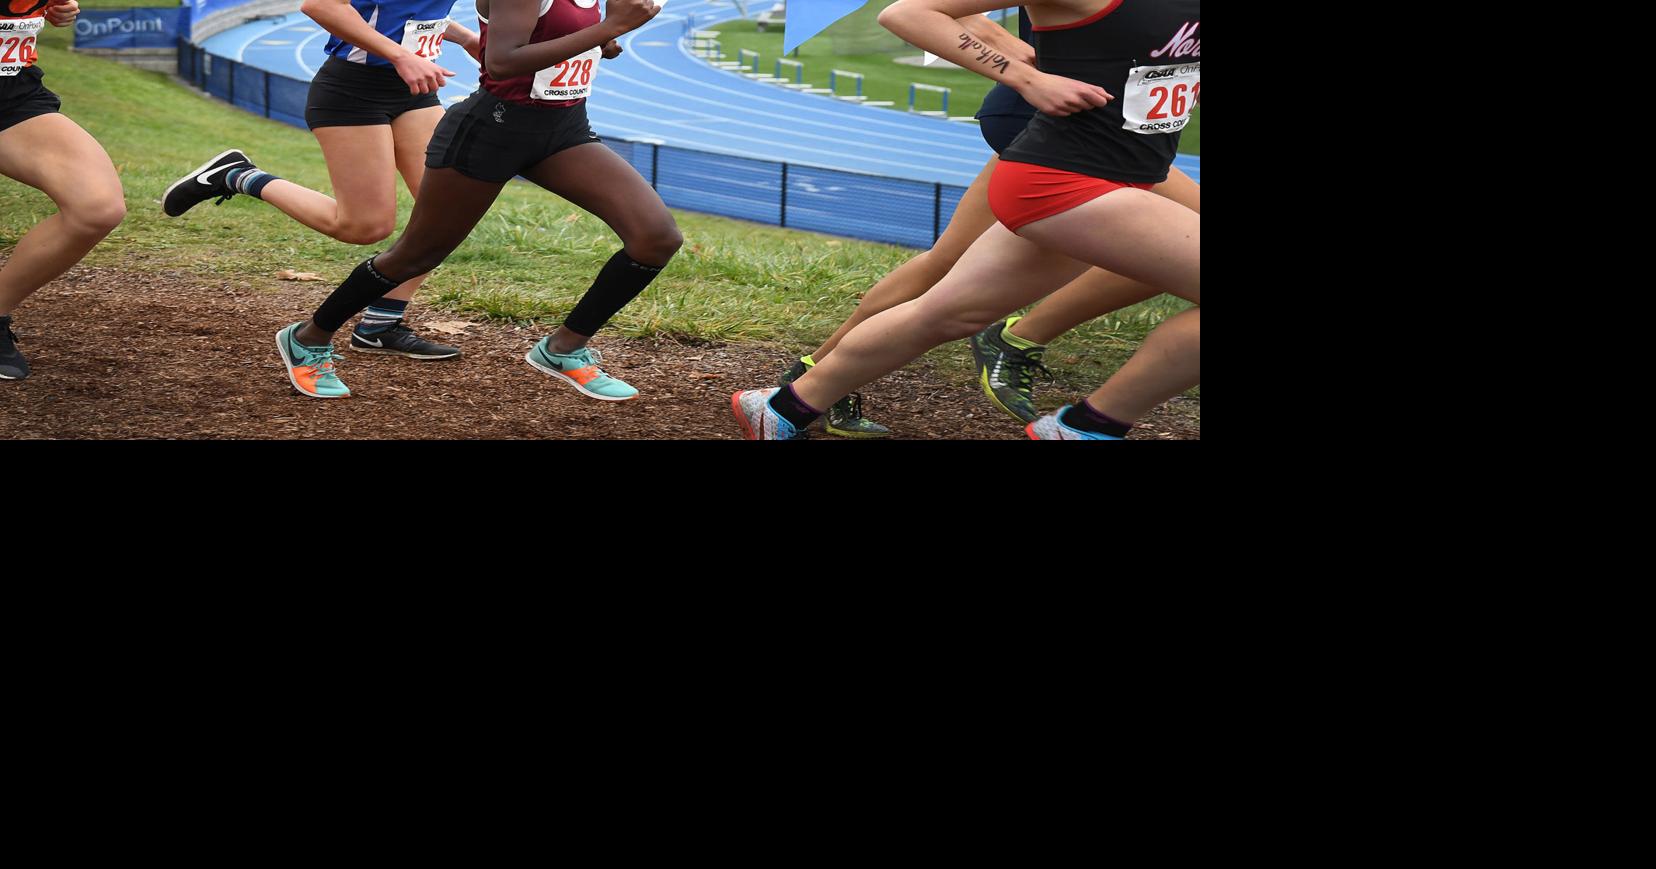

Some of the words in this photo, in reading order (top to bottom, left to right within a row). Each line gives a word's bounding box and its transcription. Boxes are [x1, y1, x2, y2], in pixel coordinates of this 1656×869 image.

[75, 17, 162, 36] OnPoint
[0, 36, 35, 63] 26
[549, 58, 593, 87] 228
[543, 89, 569, 97] CROSS
[1139, 121, 1171, 131] CROSS
